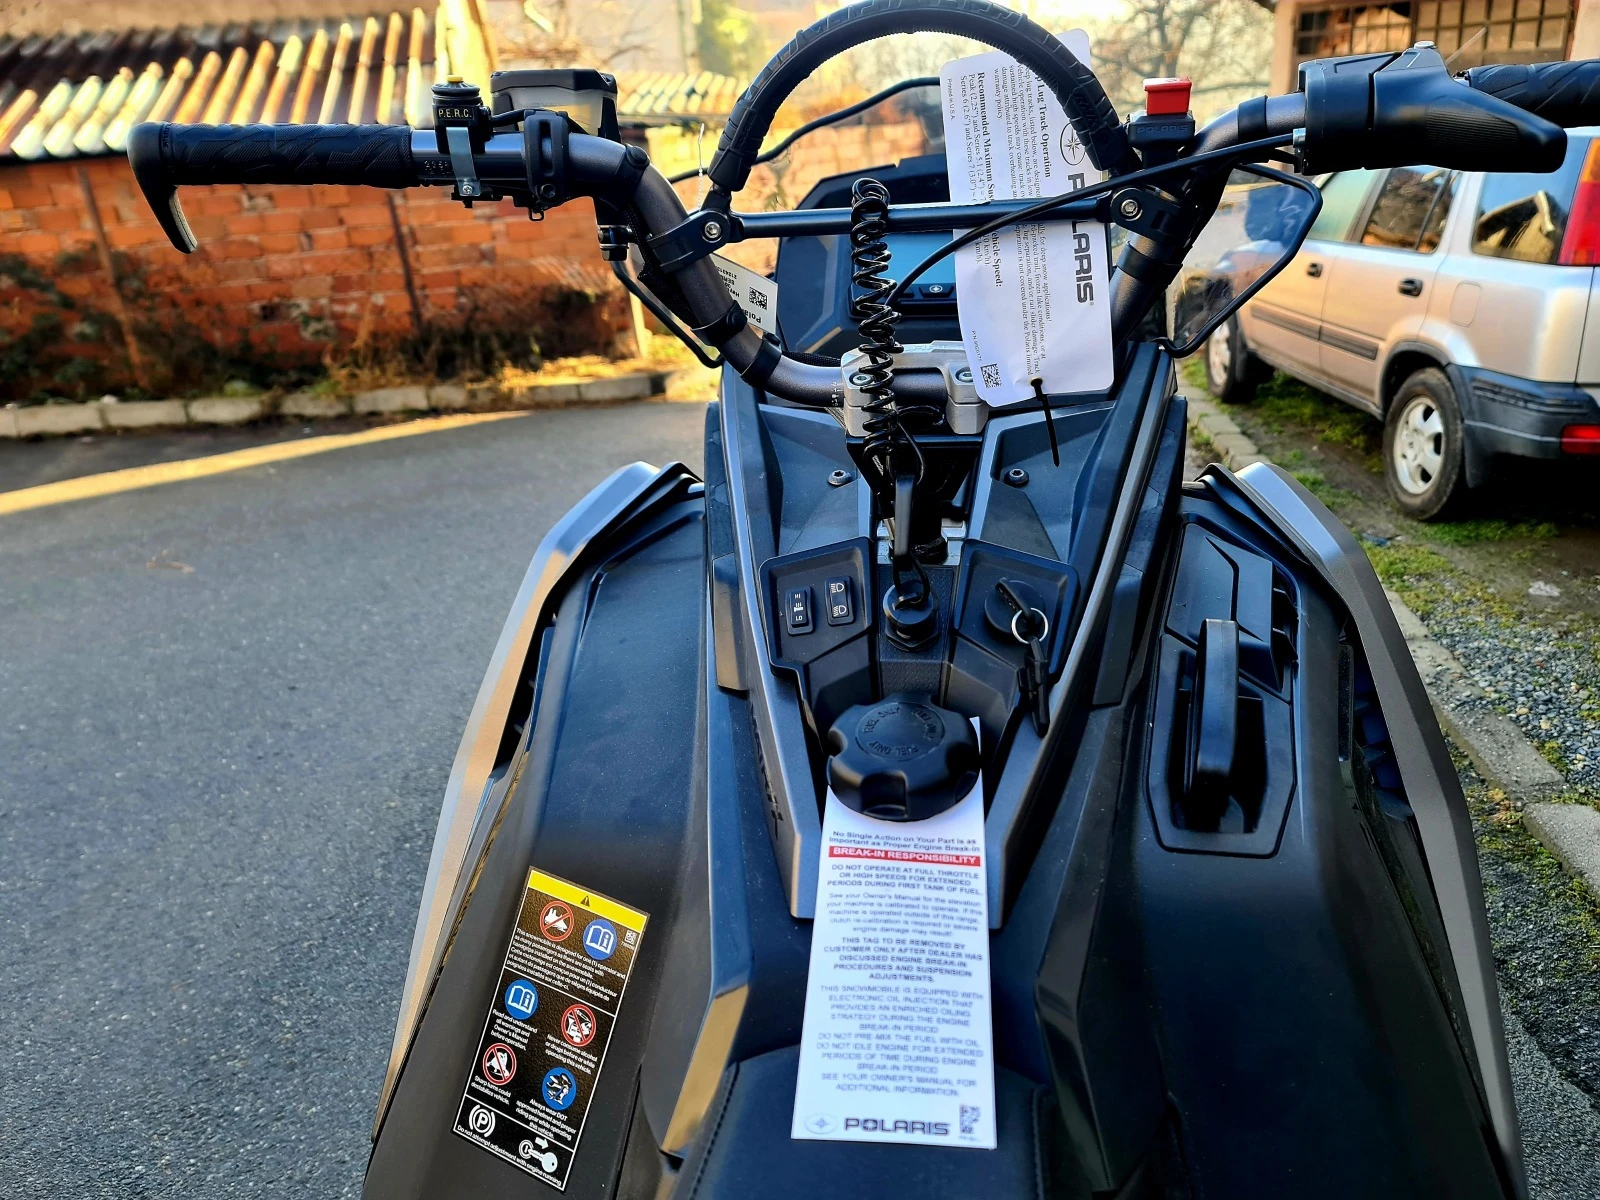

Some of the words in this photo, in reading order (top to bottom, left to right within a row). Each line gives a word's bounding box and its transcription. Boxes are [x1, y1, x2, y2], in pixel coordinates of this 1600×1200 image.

[1036, 85, 1045, 103] Lug
[438, 108, 472, 118] P.E.R.C.
[1038, 104, 1047, 131] Track
[976, 72, 990, 136] Recommended
[983, 139, 993, 182] Maximum
[1137, 125, 1188, 134] POLARIS
[1040, 133, 1052, 178] Operation
[1068, 173, 1094, 304] PLARIS
[992, 258, 1003, 287] Speed:
[744, 309, 762, 324] Pola
[829, 837, 868, 845] Important
[883, 841, 910, 849] Proper
[914, 843, 941, 851] Engine
[945, 844, 979, 852] Break-in
[833, 847, 885, 857] BREAK-IN
[887, 851, 975, 864] RESPONSIBILITY
[927, 877, 970, 885] EXTENDED
[937, 870, 978, 878] THROTTLE
[827, 878, 861, 887] PERIODS
[959, 887, 982, 895] FUEL.
[843, 1117, 949, 1136] POLARIS
